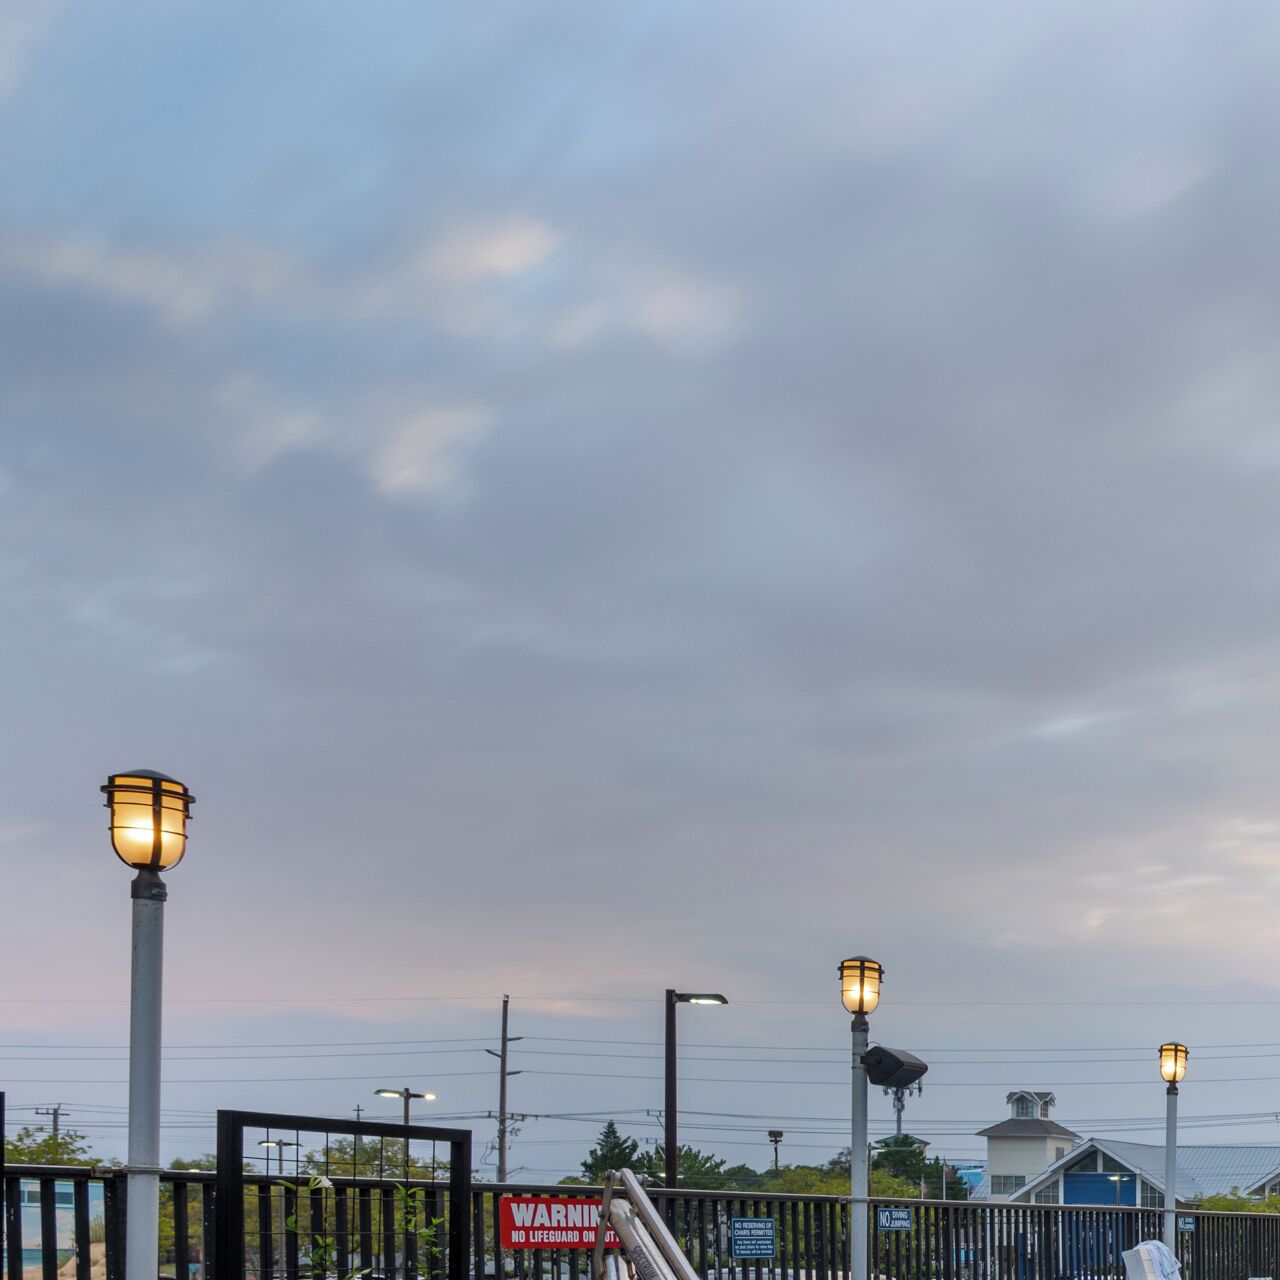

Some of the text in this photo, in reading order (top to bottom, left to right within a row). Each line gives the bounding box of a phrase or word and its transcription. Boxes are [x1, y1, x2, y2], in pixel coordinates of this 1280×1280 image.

[511, 1203, 611, 1227] WARNIN
[880, 1211, 908, 1227] NO DIVING
[890, 1220, 910, 1228] JUMPING
[512, 1230, 526, 1243] NO
[529, 1230, 579, 1243] LIFEGUARD
[582, 1231, 595, 1243] ON
